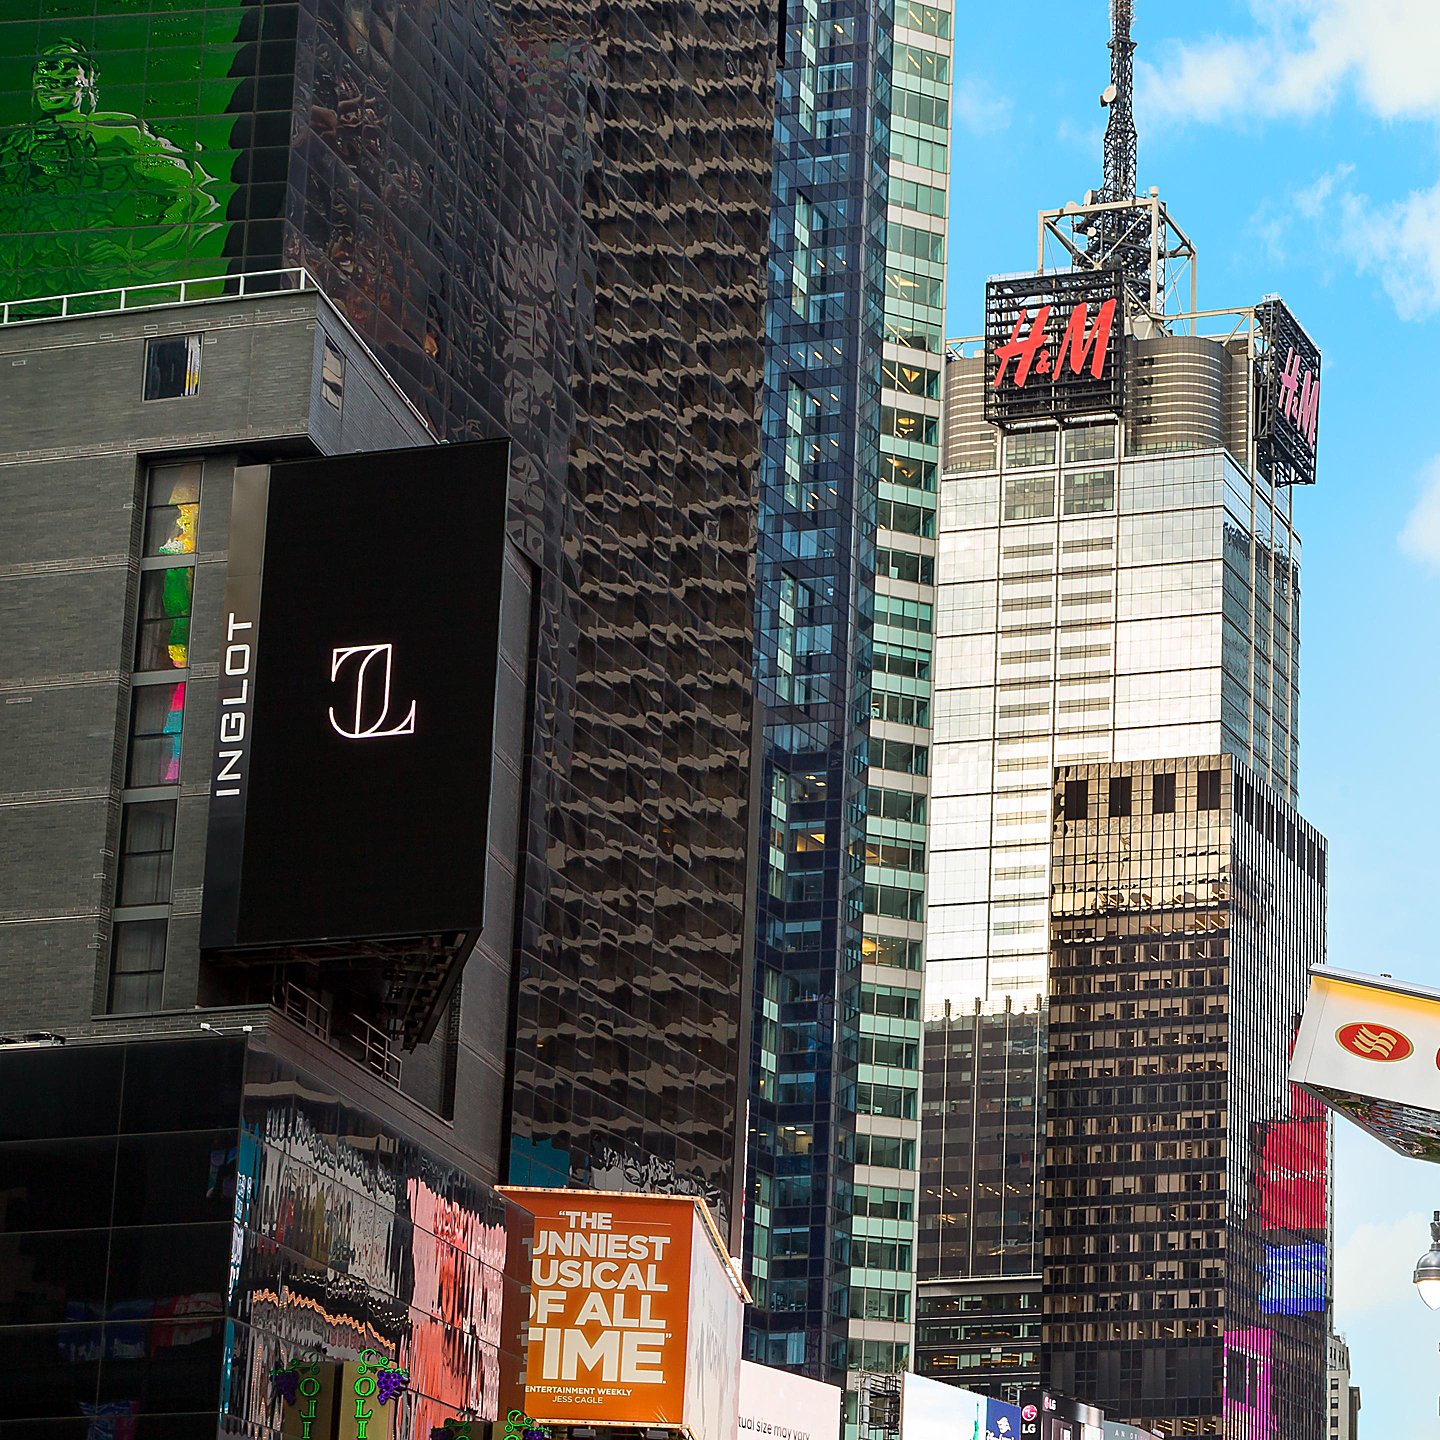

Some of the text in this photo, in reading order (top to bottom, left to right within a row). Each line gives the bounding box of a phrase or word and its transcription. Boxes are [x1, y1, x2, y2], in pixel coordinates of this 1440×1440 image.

[993, 298, 1117, 388] H&M
[1278, 346, 1320, 449] H&M
[216, 612, 253, 797] INGLOT
[532, 1230, 671, 1261] UNNIEST
[531, 1258, 669, 1292] USICAL
[574, 1291, 667, 1330] ALL
[525, 1385, 633, 1397] ENTERTAINMENT WEEKLY
[552, 1395, 604, 1405] JESS CAGLE
[738, 1415, 755, 1431] tual
[756, 1417, 772, 1435] size
[773, 1425, 792, 1440] may
[1022, 1423, 1036, 1434] LG
